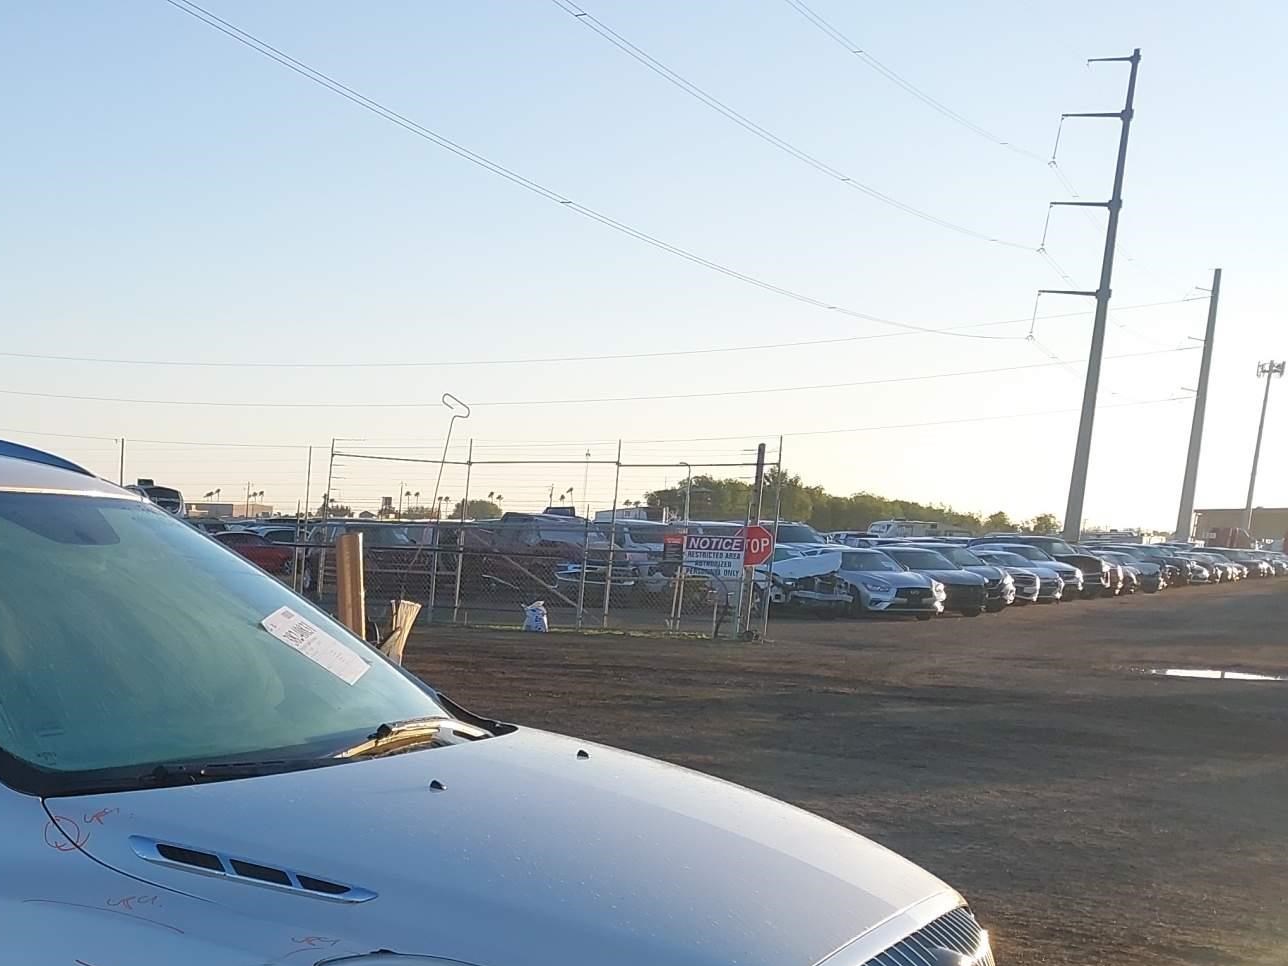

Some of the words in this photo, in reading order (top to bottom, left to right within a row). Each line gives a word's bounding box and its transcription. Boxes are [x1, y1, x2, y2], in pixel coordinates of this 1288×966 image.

[689, 537, 742, 551] NOTICE
[745, 538, 770, 554] TOP
[687, 551, 723, 559] RESTRICTED
[725, 552, 741, 560] AREA
[723, 568, 740, 577] ONLY
